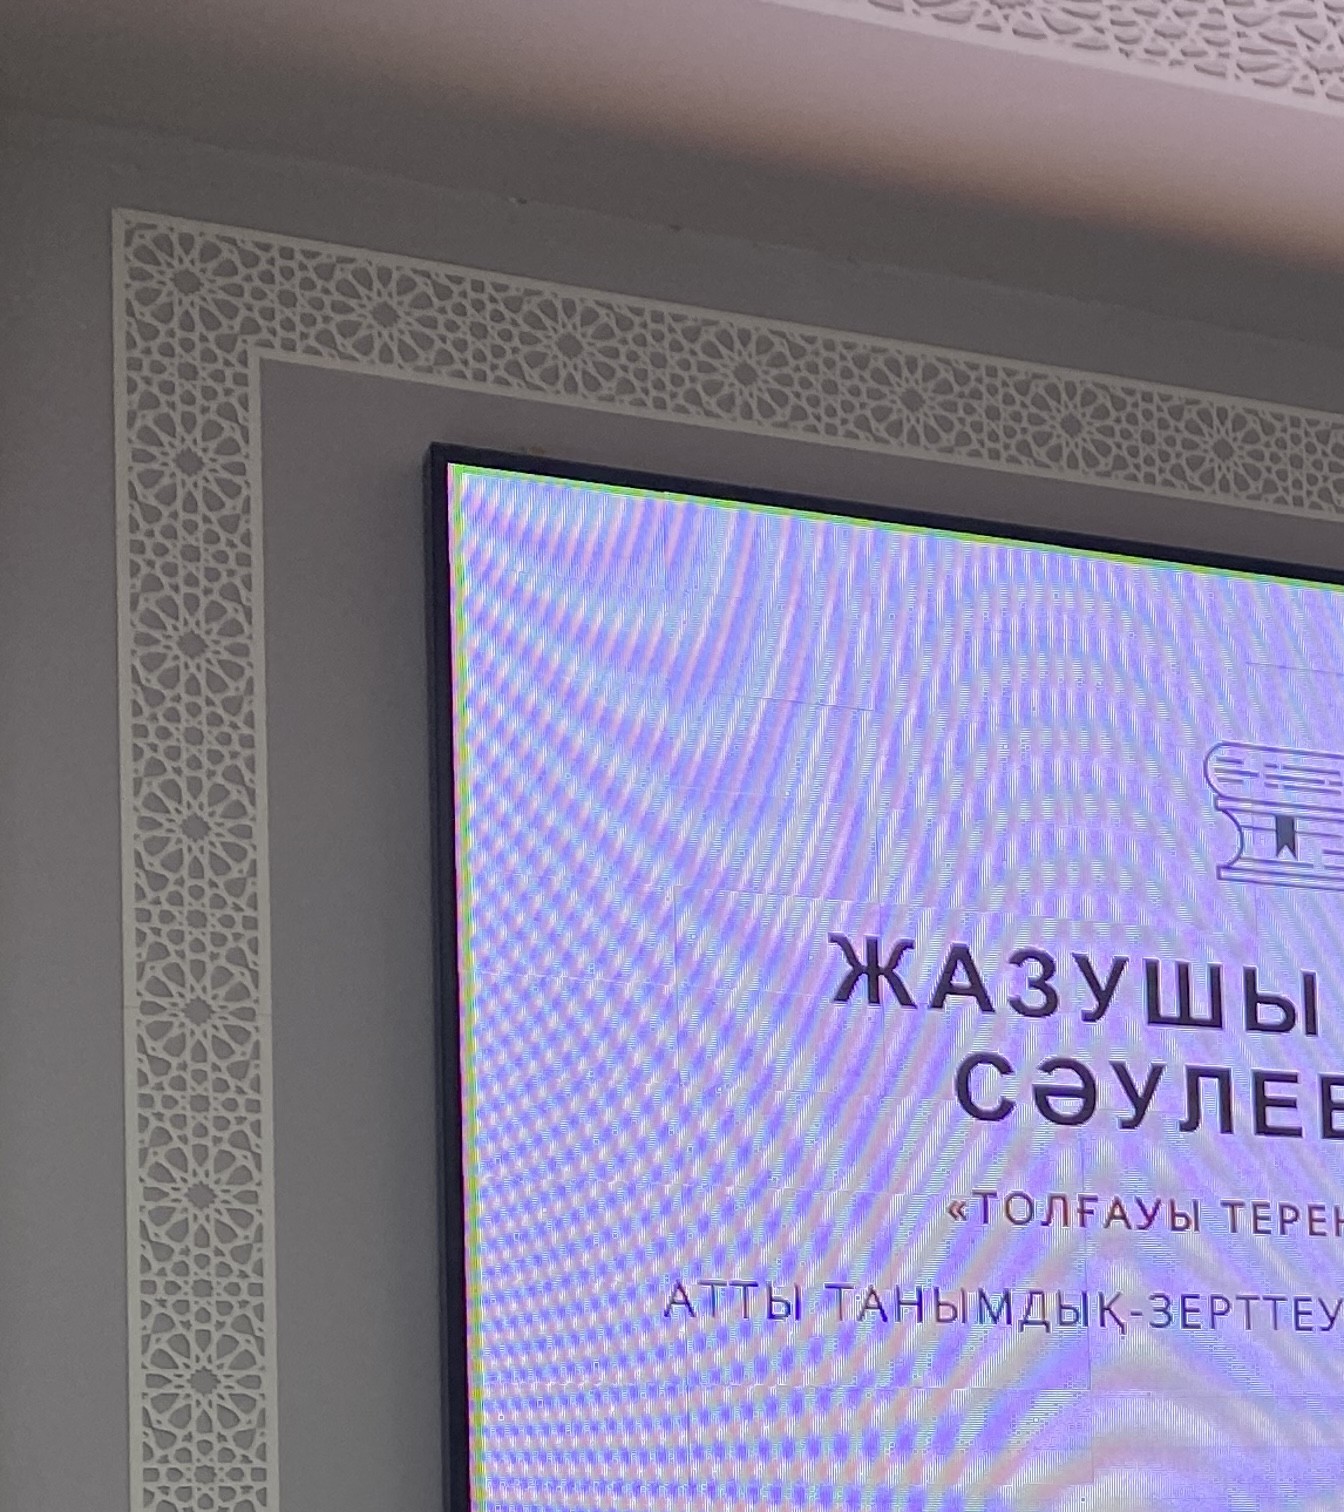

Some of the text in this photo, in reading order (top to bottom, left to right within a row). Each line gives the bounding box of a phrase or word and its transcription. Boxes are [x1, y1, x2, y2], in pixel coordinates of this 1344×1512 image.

[828, 932, 1318, 1036] ЖАЗУШЫ
[947, 1188, 1200, 1233] «ТОЛҒАУЫ
[663, 1278, 801, 1321] АТТЫ
[824, 1282, 1343, 1335] ТАНЫМДЫҚ-ЗЕРТТЕУ
